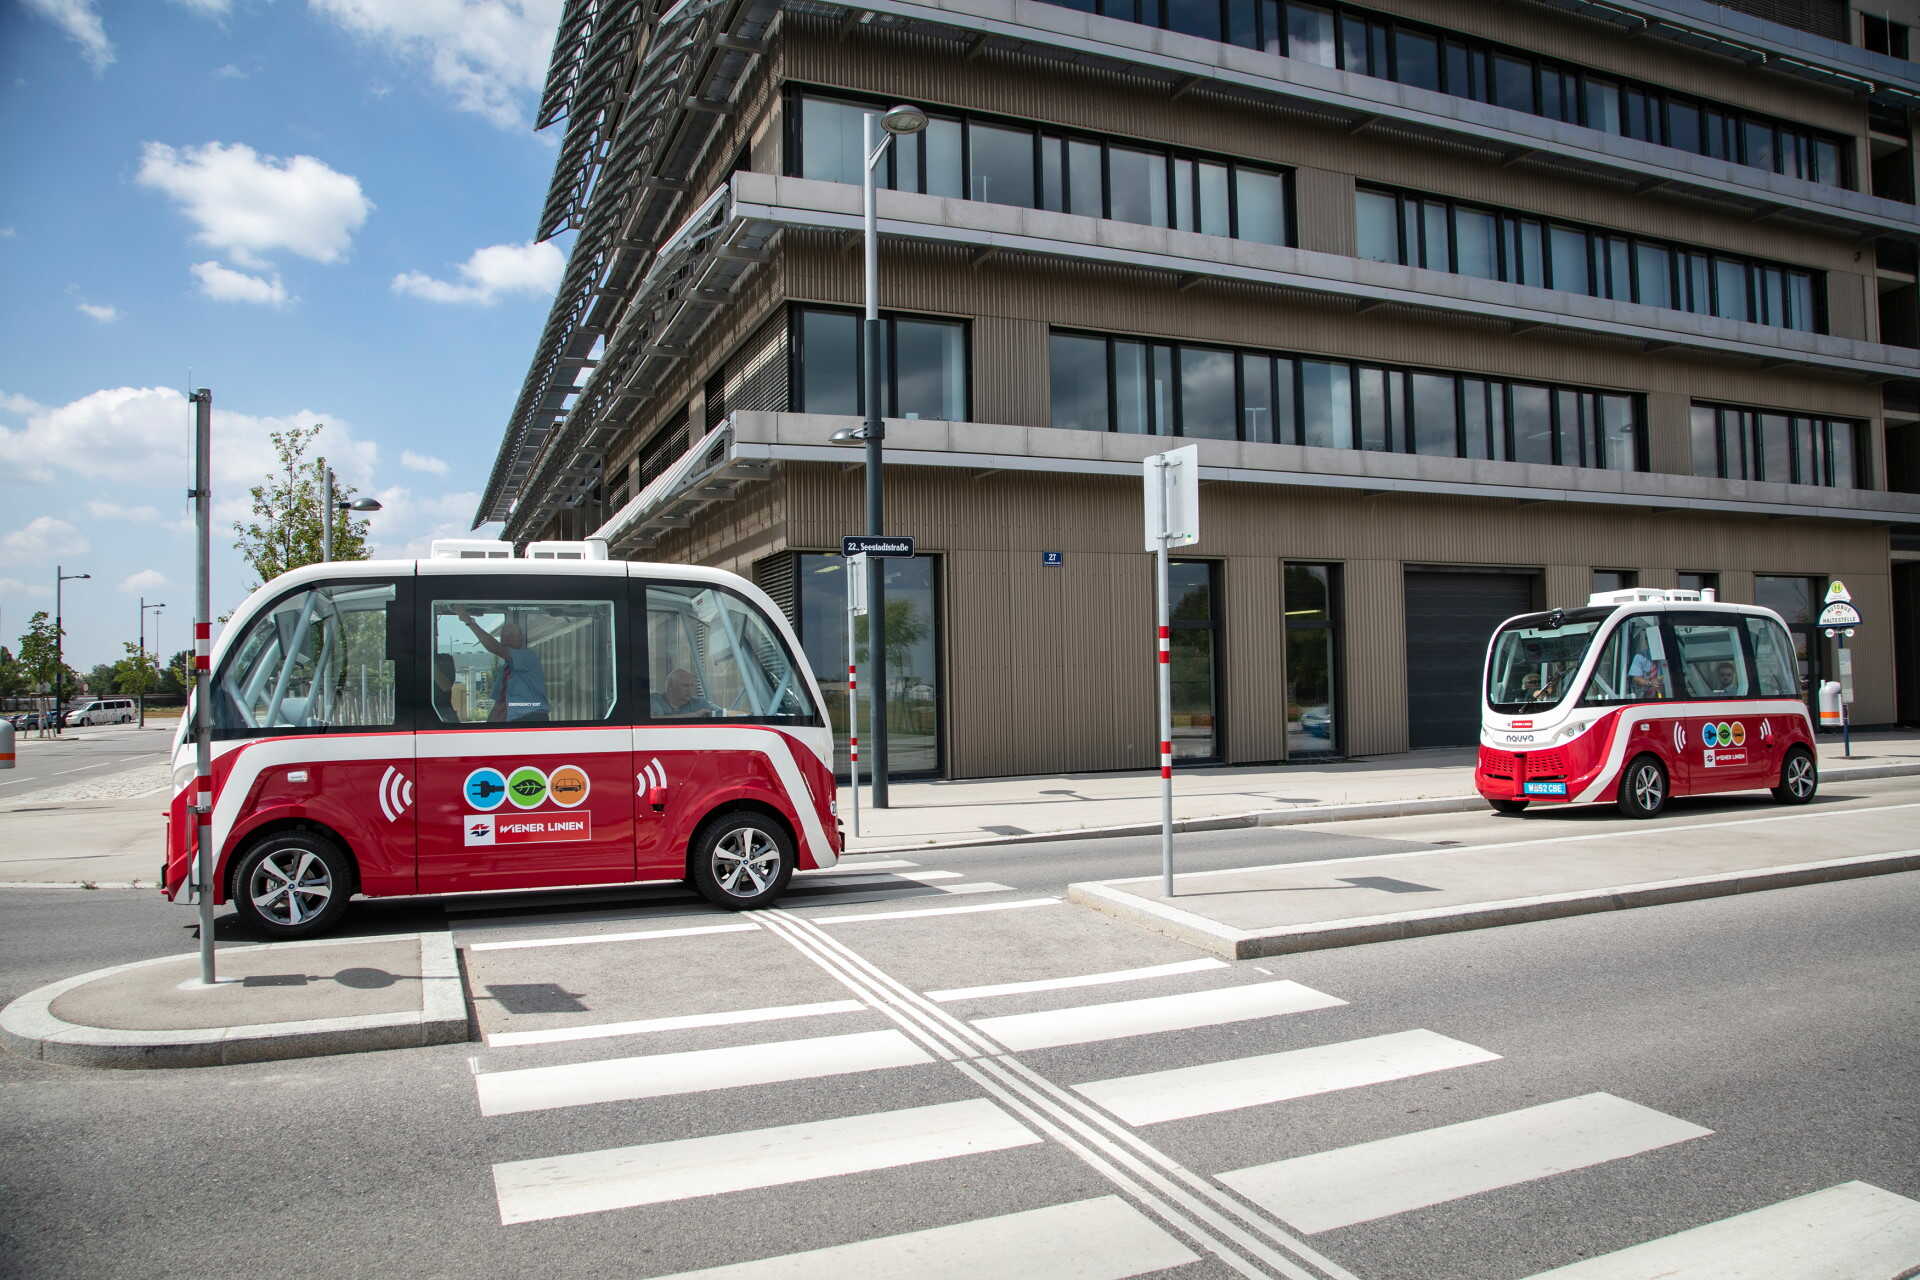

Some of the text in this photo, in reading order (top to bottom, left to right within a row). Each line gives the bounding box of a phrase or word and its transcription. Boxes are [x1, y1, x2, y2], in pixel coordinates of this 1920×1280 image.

[860, 542, 909, 551] Seestadtstraße
[1048, 553, 1056, 561] 27
[499, 821, 584, 834] WIENER LINIEN
